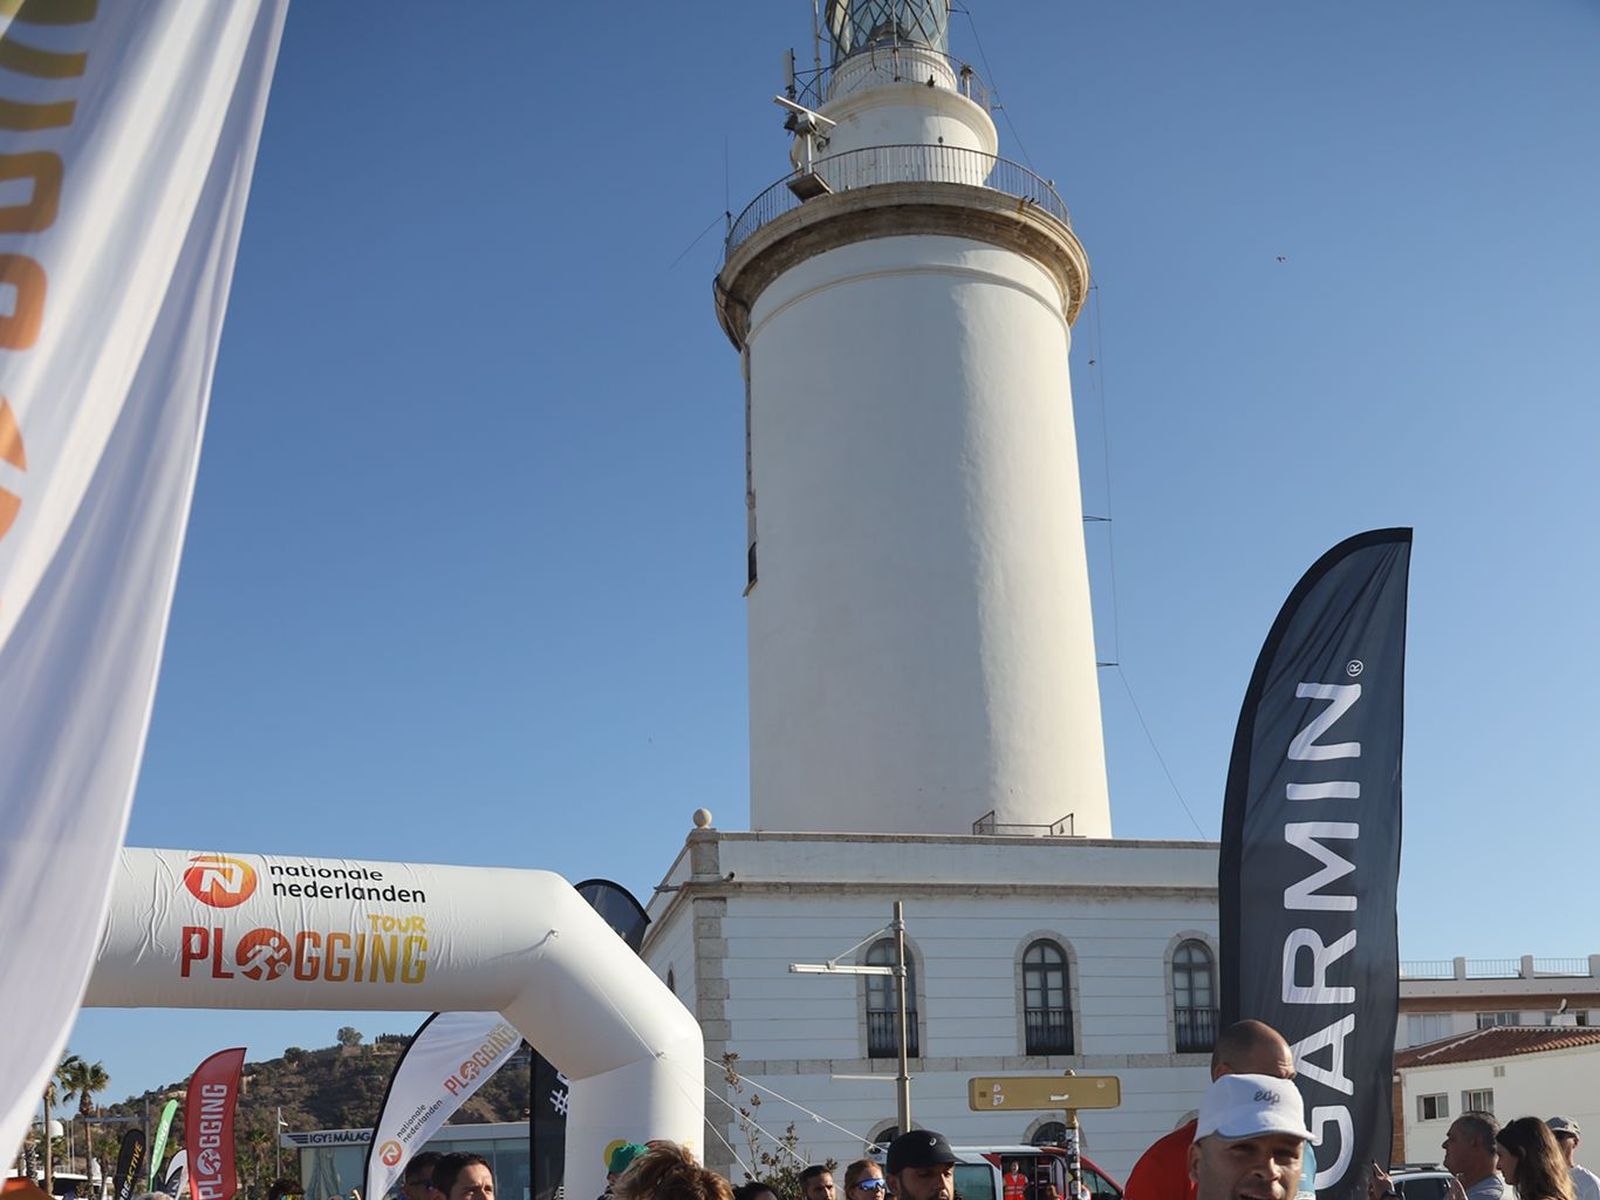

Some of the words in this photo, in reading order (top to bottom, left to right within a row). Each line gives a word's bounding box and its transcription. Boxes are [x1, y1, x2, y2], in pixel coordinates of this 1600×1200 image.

[270, 865, 383, 881] nationale
[273, 881, 426, 903] nederlanden
[368, 914, 427, 933] TOUR
[181, 926, 428, 984] PLOGGING
[397, 1104, 426, 1138] nationale
[403, 1099, 443, 1143] nederlanden
[197, 1084, 227, 1200] PLOGGING
[310, 1134, 328, 1144] IGY
[334, 1131, 371, 1143] MÁLAG
